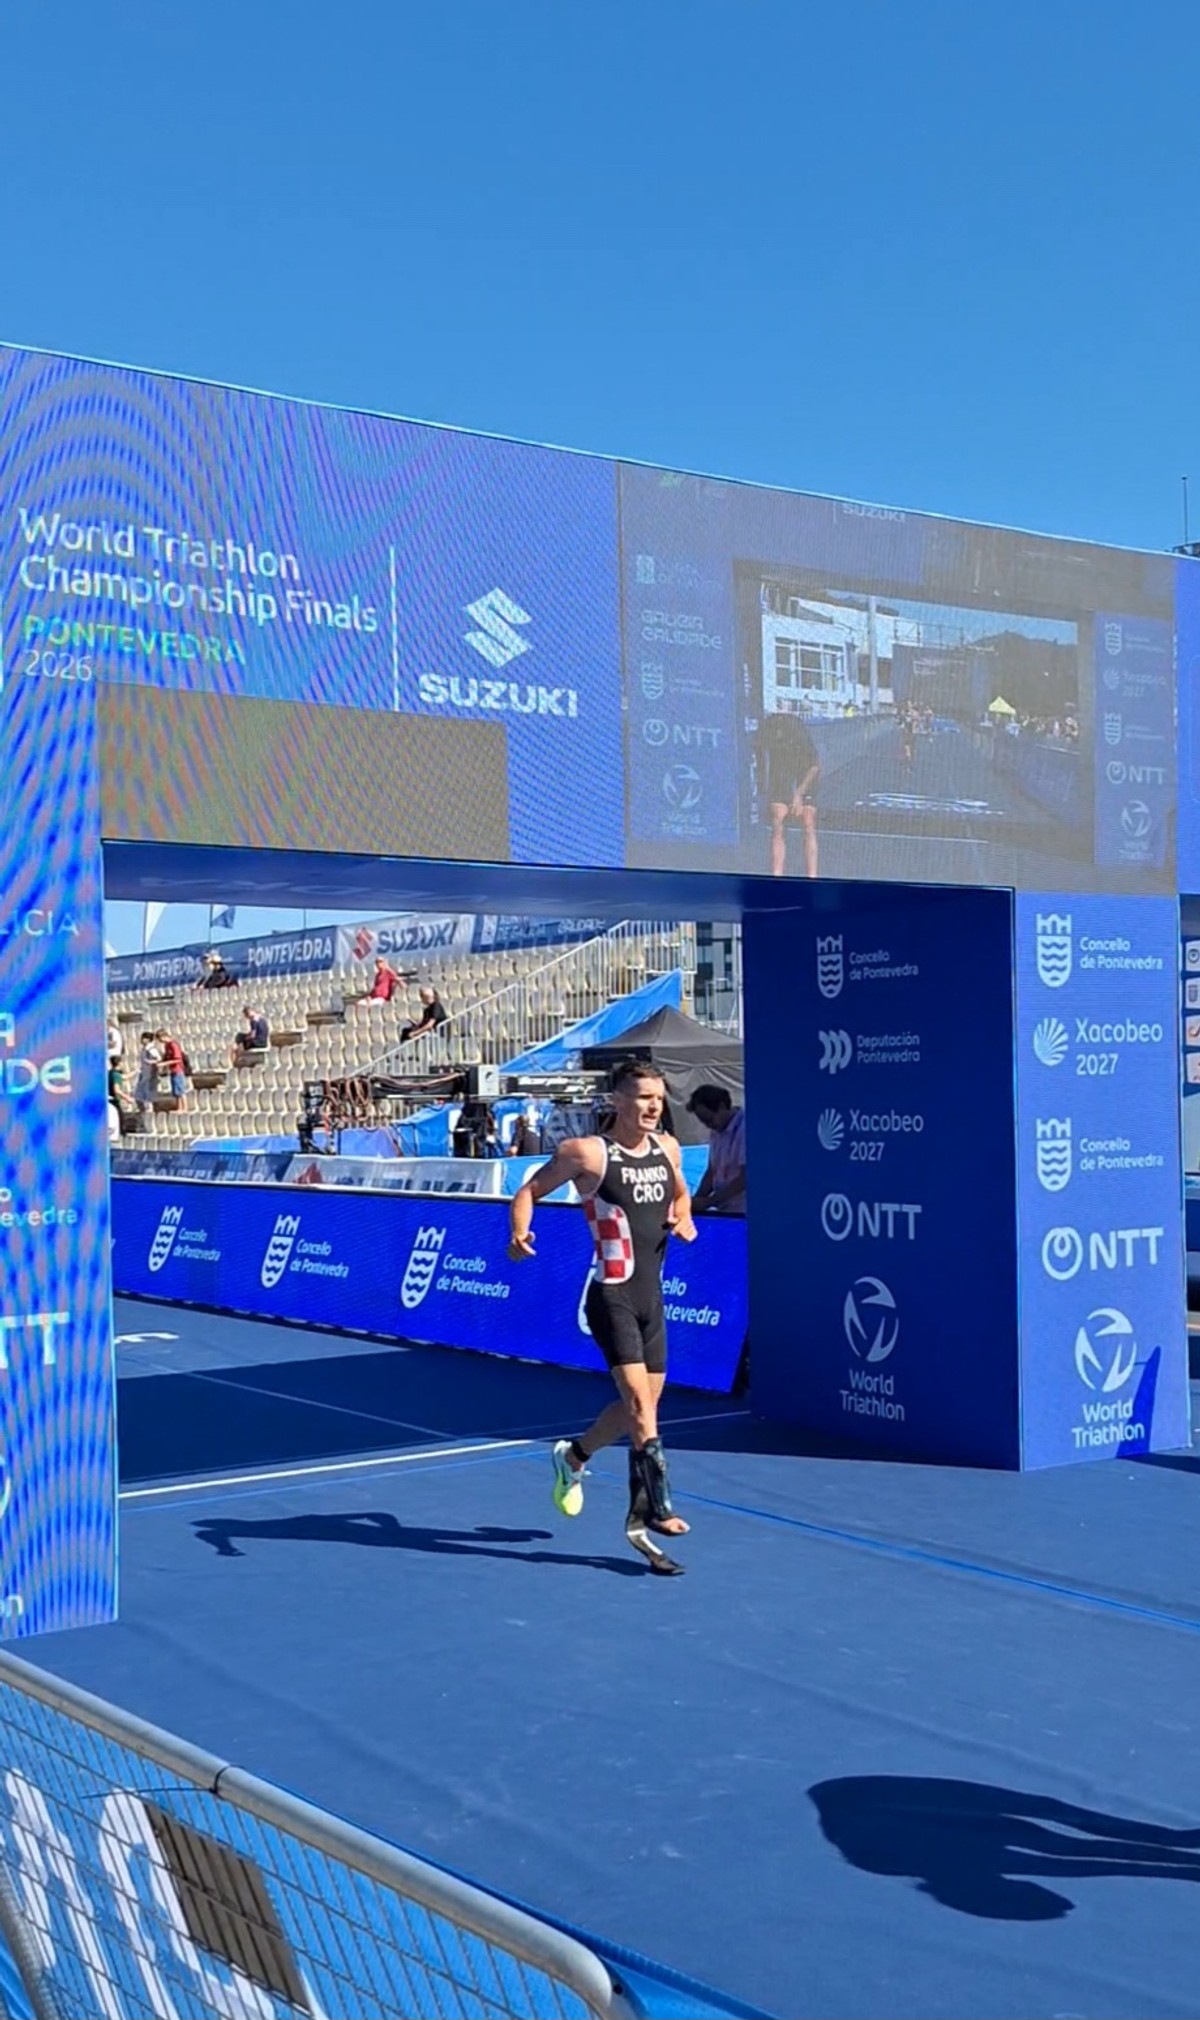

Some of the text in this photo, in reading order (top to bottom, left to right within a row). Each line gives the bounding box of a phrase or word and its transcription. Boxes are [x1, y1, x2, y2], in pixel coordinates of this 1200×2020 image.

[19, 507, 299, 580] World Triathlon
[19, 554, 377, 632] Championship Finals
[24, 614, 246, 666] PONTEVEDRA
[24, 650, 93, 681] 2026
[419, 672, 578, 717] SUZUKI
[673, 725, 722, 747] NTT
[1129, 764, 1167, 785] NTT
[0, 908, 80, 937] ICIA
[377, 921, 458, 954] SUZUKI
[1080, 936, 1131, 952] Concello
[248, 935, 333, 968] PONTEVEDRA
[849, 949, 890, 965] Concello
[1080, 954, 1164, 970] de Pontevedra
[849, 963, 919, 980] de Pontevedra
[856, 1031, 921, 1051] Deputación
[1075, 1017, 1164, 1044] Xacobeo
[856, 1048, 921, 1063] Pontevedra
[1076, 1052, 1119, 1076] 2027
[849, 1108, 924, 1133] Xacobeo
[849, 1141, 885, 1161] 2027
[1080, 1137, 1131, 1153] Concello
[621, 1164, 668, 1184] FRANKO
[1080, 1154, 1164, 1171] de Pontevedra
[633, 1184, 665, 1203] CRO
[0, 1206, 78, 1228] evedra
[858, 1201, 922, 1240] NTT
[296, 1238, 332, 1256] Concello
[1089, 1227, 1164, 1271] NTT
[290, 1259, 350, 1279] de Pontevedra
[442, 1253, 487, 1273] Concello
[436, 1274, 510, 1299] de Pontevedra
[662, 1275, 688, 1297] ello
[663, 1303, 721, 1327] tevedra
[848, 1368, 895, 1396] World
[839, 1388, 906, 1422] Triathlon
[1082, 1397, 1134, 1424] World
[1071, 1421, 1146, 1449] Triathlon
